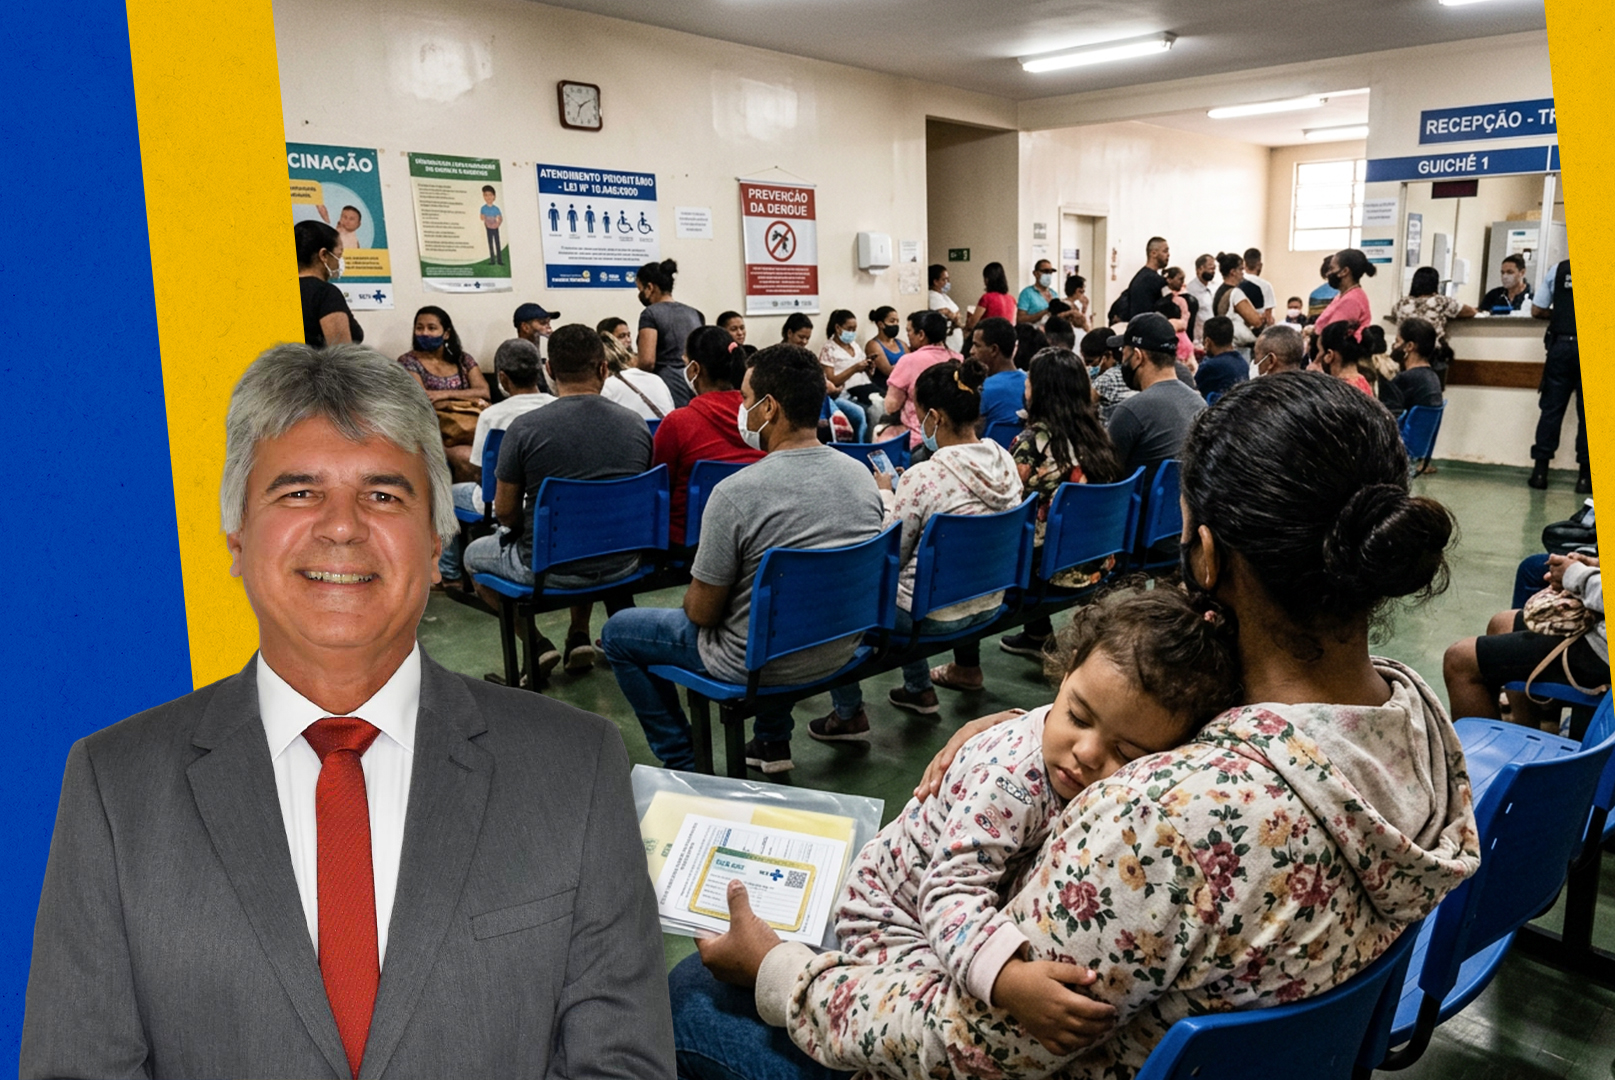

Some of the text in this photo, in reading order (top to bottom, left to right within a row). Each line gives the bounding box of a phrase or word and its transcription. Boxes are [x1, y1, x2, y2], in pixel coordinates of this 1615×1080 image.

[1425, 109, 1522, 135] RECEPÇÃO
[1481, 156, 1489, 170] 1
[750, 202, 766, 213] DA
